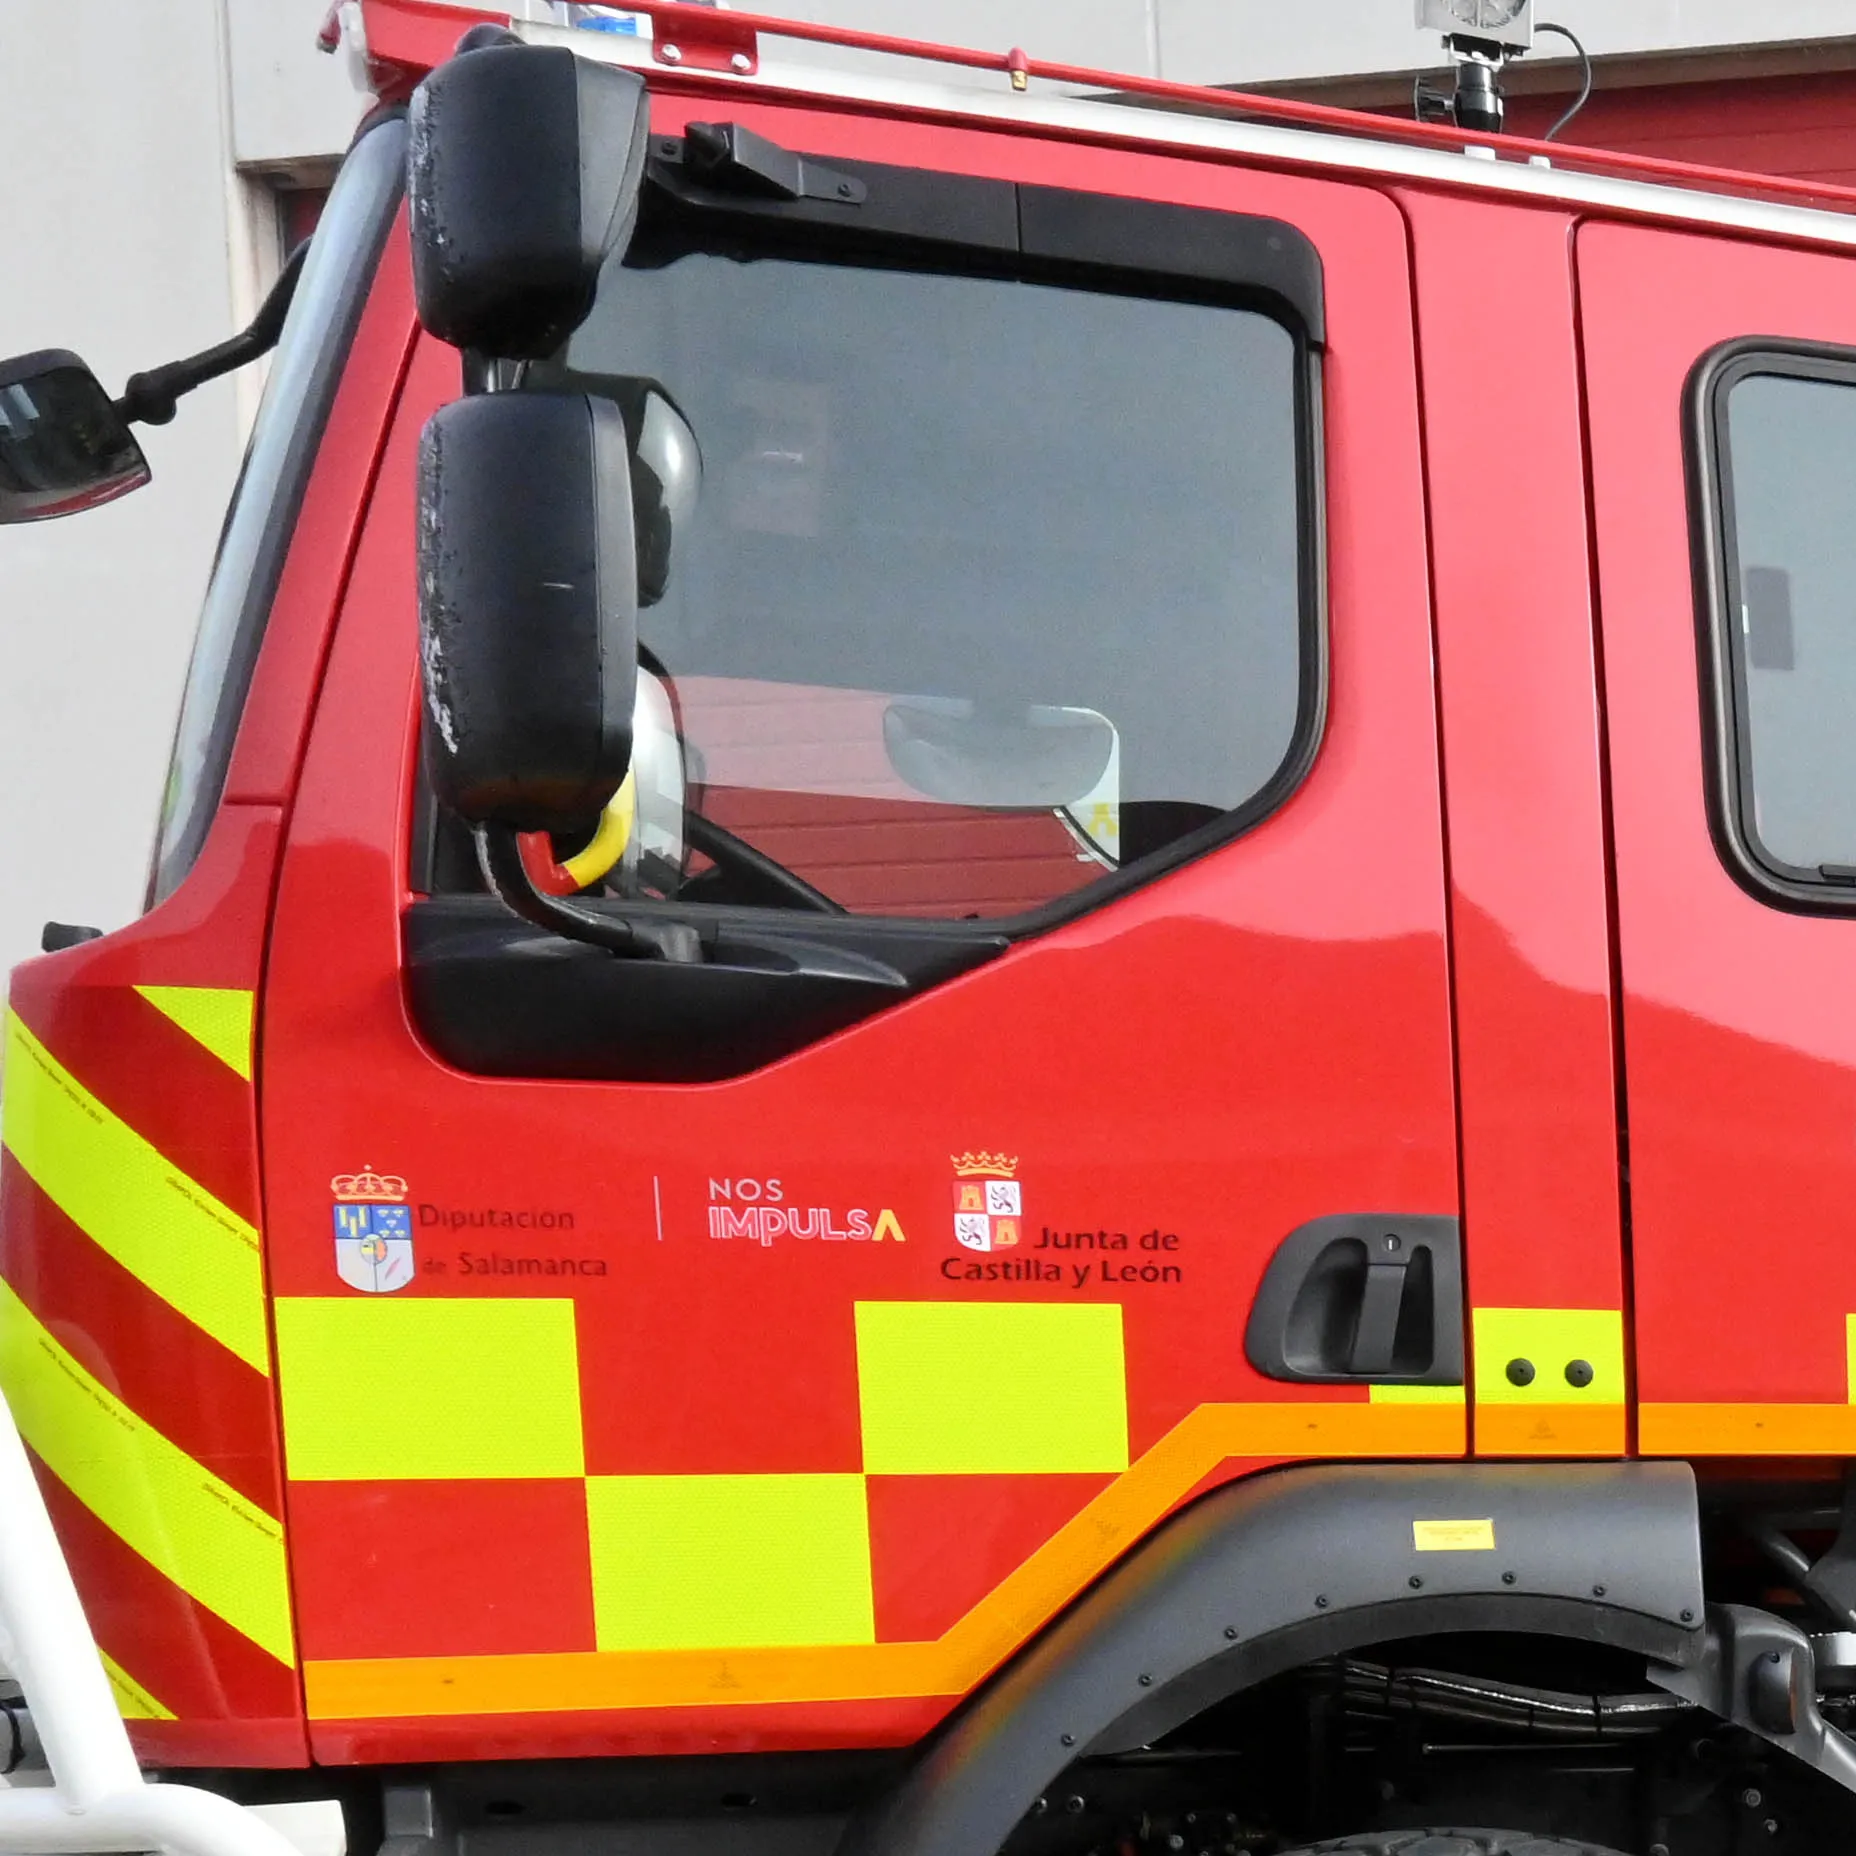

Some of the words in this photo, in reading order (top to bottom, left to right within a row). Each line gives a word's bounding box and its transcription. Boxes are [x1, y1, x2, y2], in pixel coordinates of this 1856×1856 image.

[708, 1176, 785, 1202] NOS
[708, 1205, 907, 1248] IMPULSA
[1033, 1226, 1129, 1250] Junta
[1138, 1228, 1181, 1251] de
[457, 1251, 608, 1277] Salamanca
[940, 1256, 1061, 1282] Castilla
[1071, 1264, 1091, 1289] y
[1101, 1260, 1182, 1283] León
